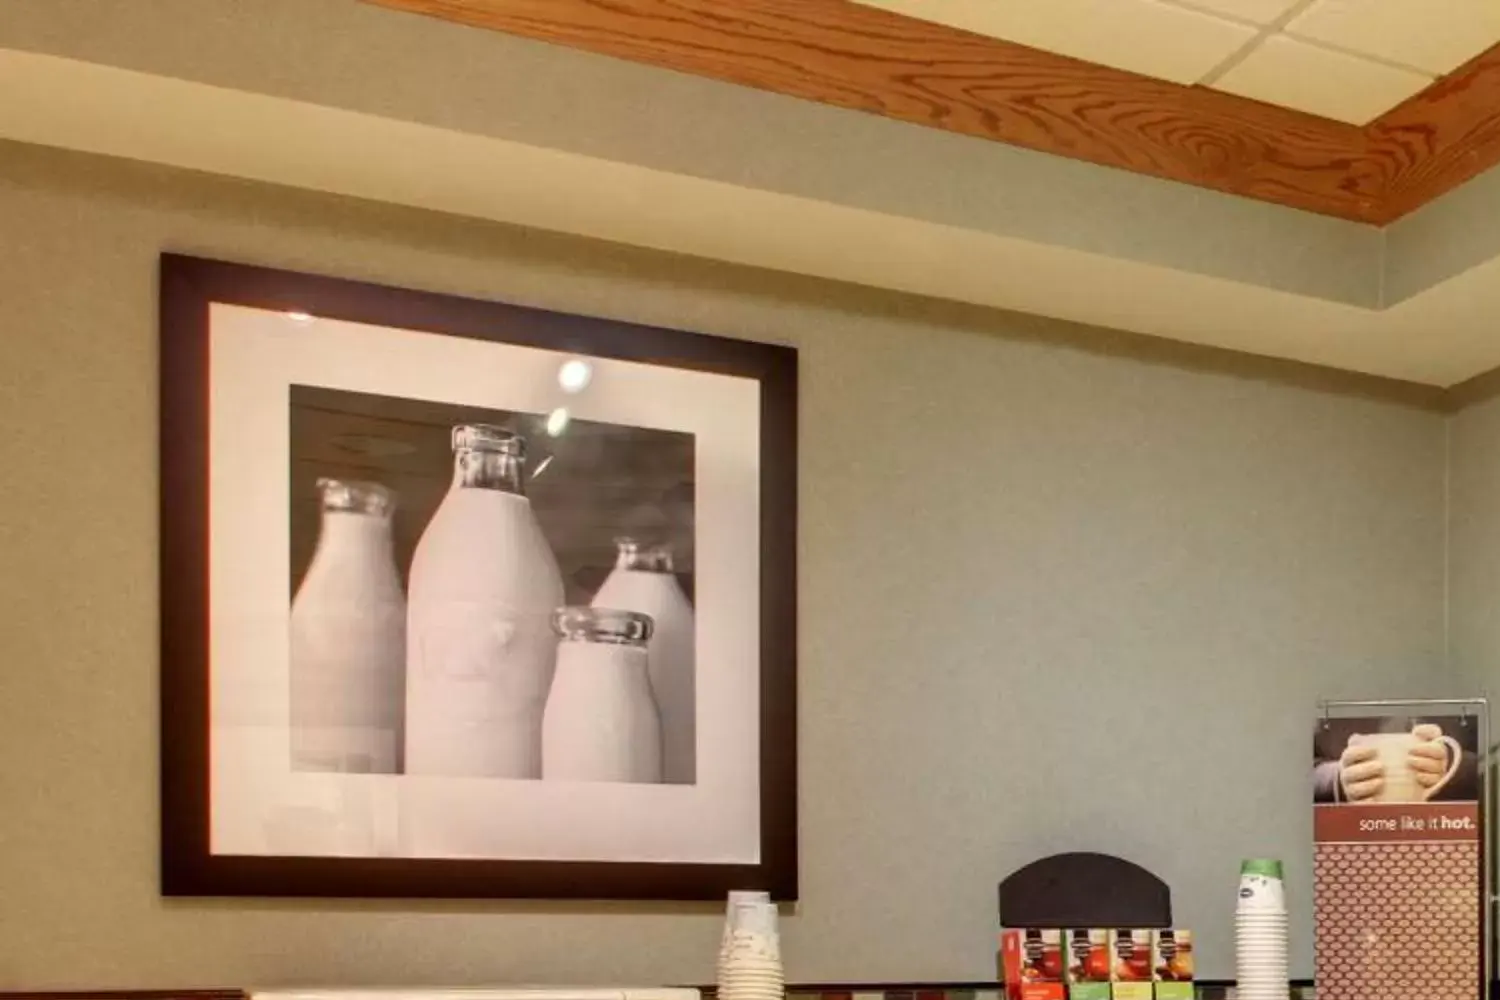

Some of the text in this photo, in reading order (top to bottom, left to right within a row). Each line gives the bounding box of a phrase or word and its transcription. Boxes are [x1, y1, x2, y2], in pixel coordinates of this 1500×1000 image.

[1360, 815, 1476, 831] some like it hot.
